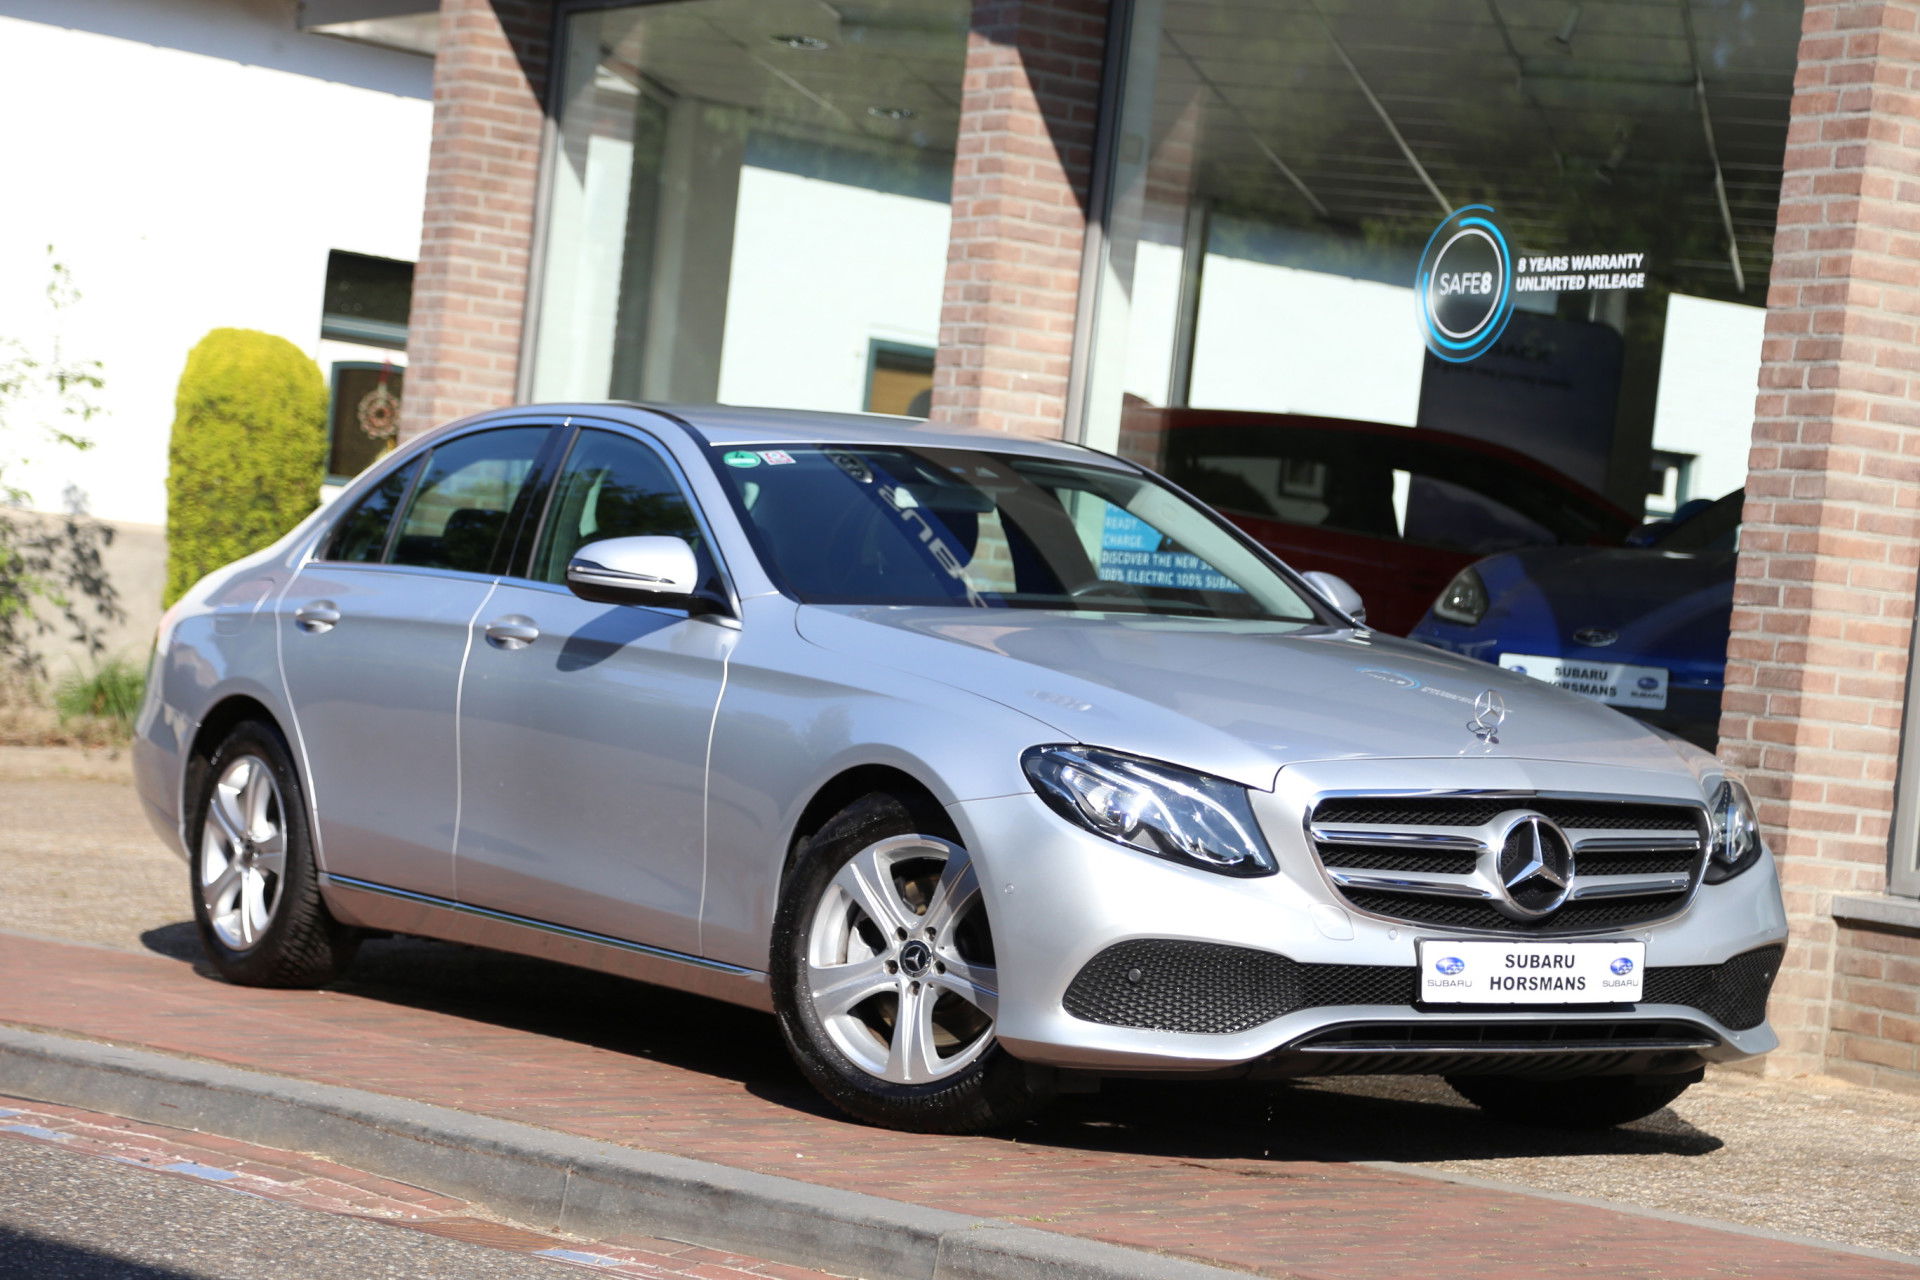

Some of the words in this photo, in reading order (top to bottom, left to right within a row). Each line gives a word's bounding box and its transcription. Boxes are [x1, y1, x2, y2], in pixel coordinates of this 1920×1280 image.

[1517, 257, 1527, 273] 8
[1528, 255, 1570, 272] YEARS
[1571, 252, 1644, 271] WARRANTY
[1439, 271, 1493, 296] SAFE8
[1516, 274, 1586, 292] UNLIMITED
[1587, 272, 1646, 290] MILEAGE
[1102, 551, 1150, 566] DISCOVER
[1152, 554, 1172, 568] THE
[1174, 555, 1199, 569] NEW
[1126, 570, 1174, 586] ELECTRIC
[1176, 572, 1203, 588] 100%
[1555, 667, 1608, 681] SUBARU
[1505, 954, 1576, 969] SUBARU
[1427, 979, 1473, 988] SUBARU
[1489, 976, 1587, 991] HORSMANS
[1602, 978, 1639, 988] SUBARU
